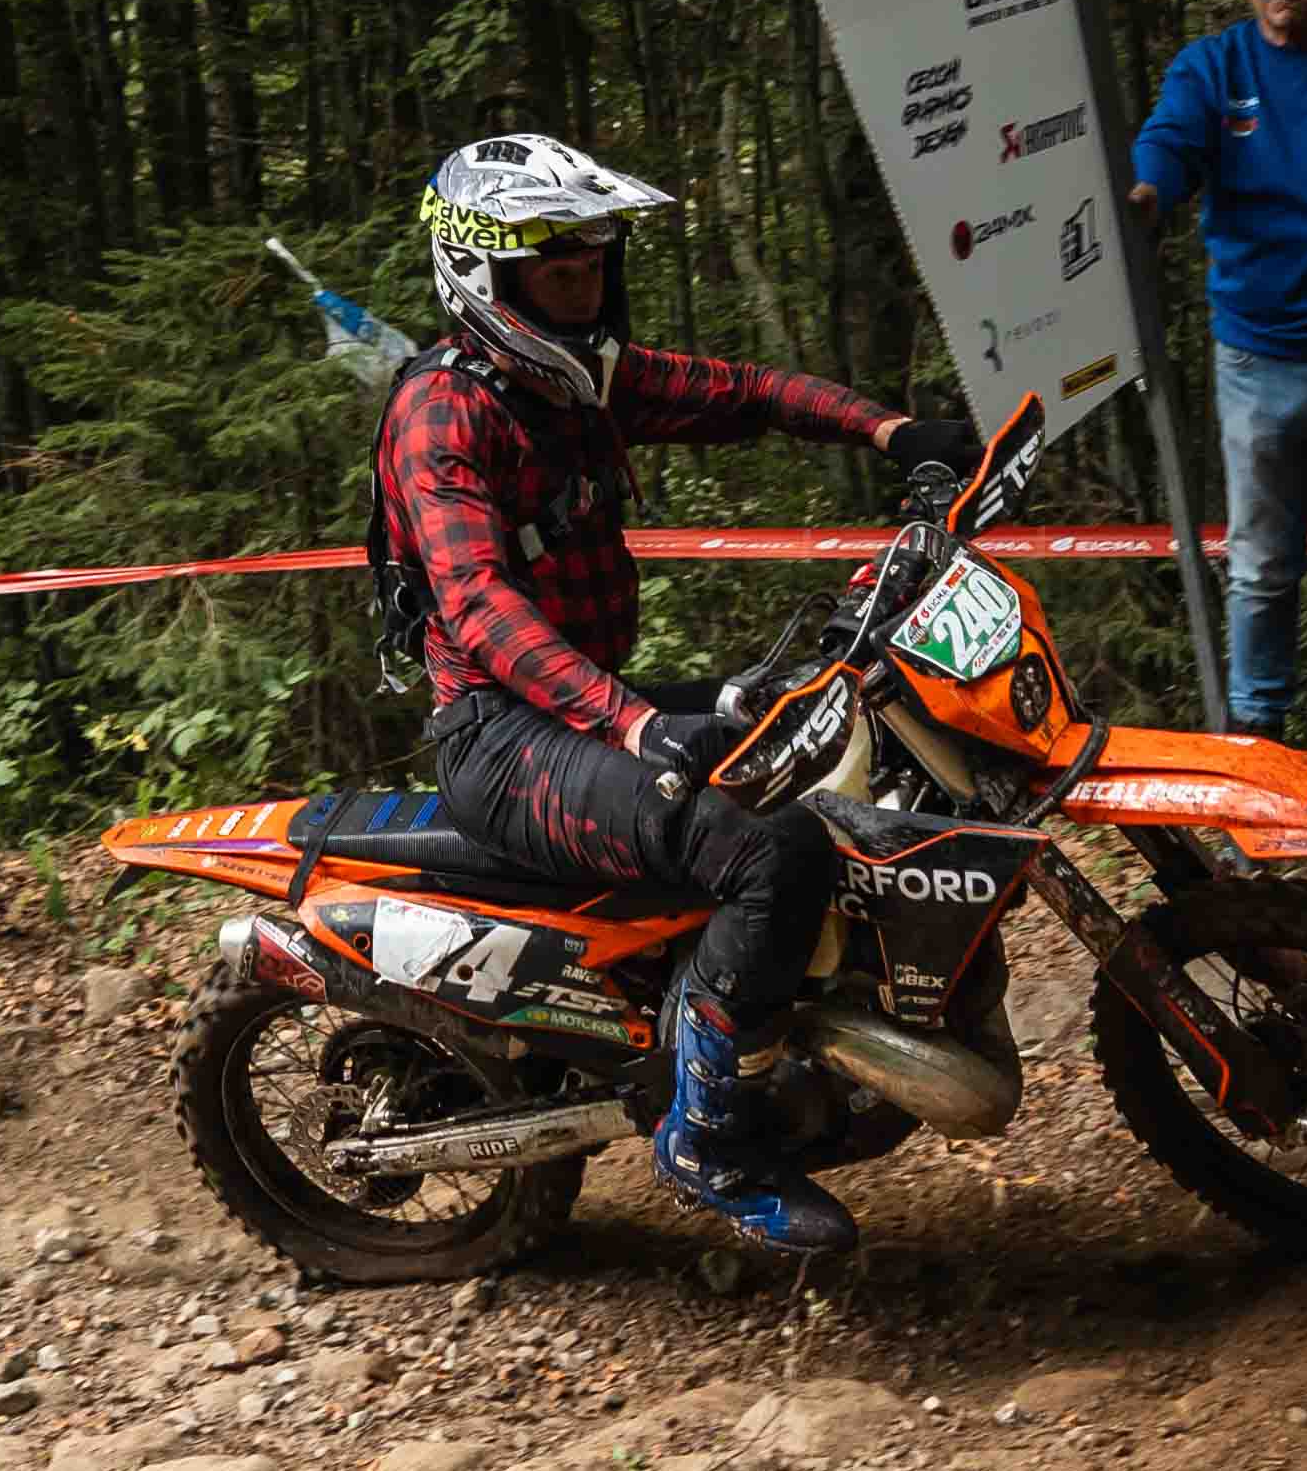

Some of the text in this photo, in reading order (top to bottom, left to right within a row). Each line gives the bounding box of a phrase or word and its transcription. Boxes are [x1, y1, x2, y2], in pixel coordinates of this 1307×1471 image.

[436, 217, 524, 250] aven
[932, 568, 1013, 672] 240
[838, 859, 997, 904] RFORD
[469, 1138, 518, 1158] RIDE
